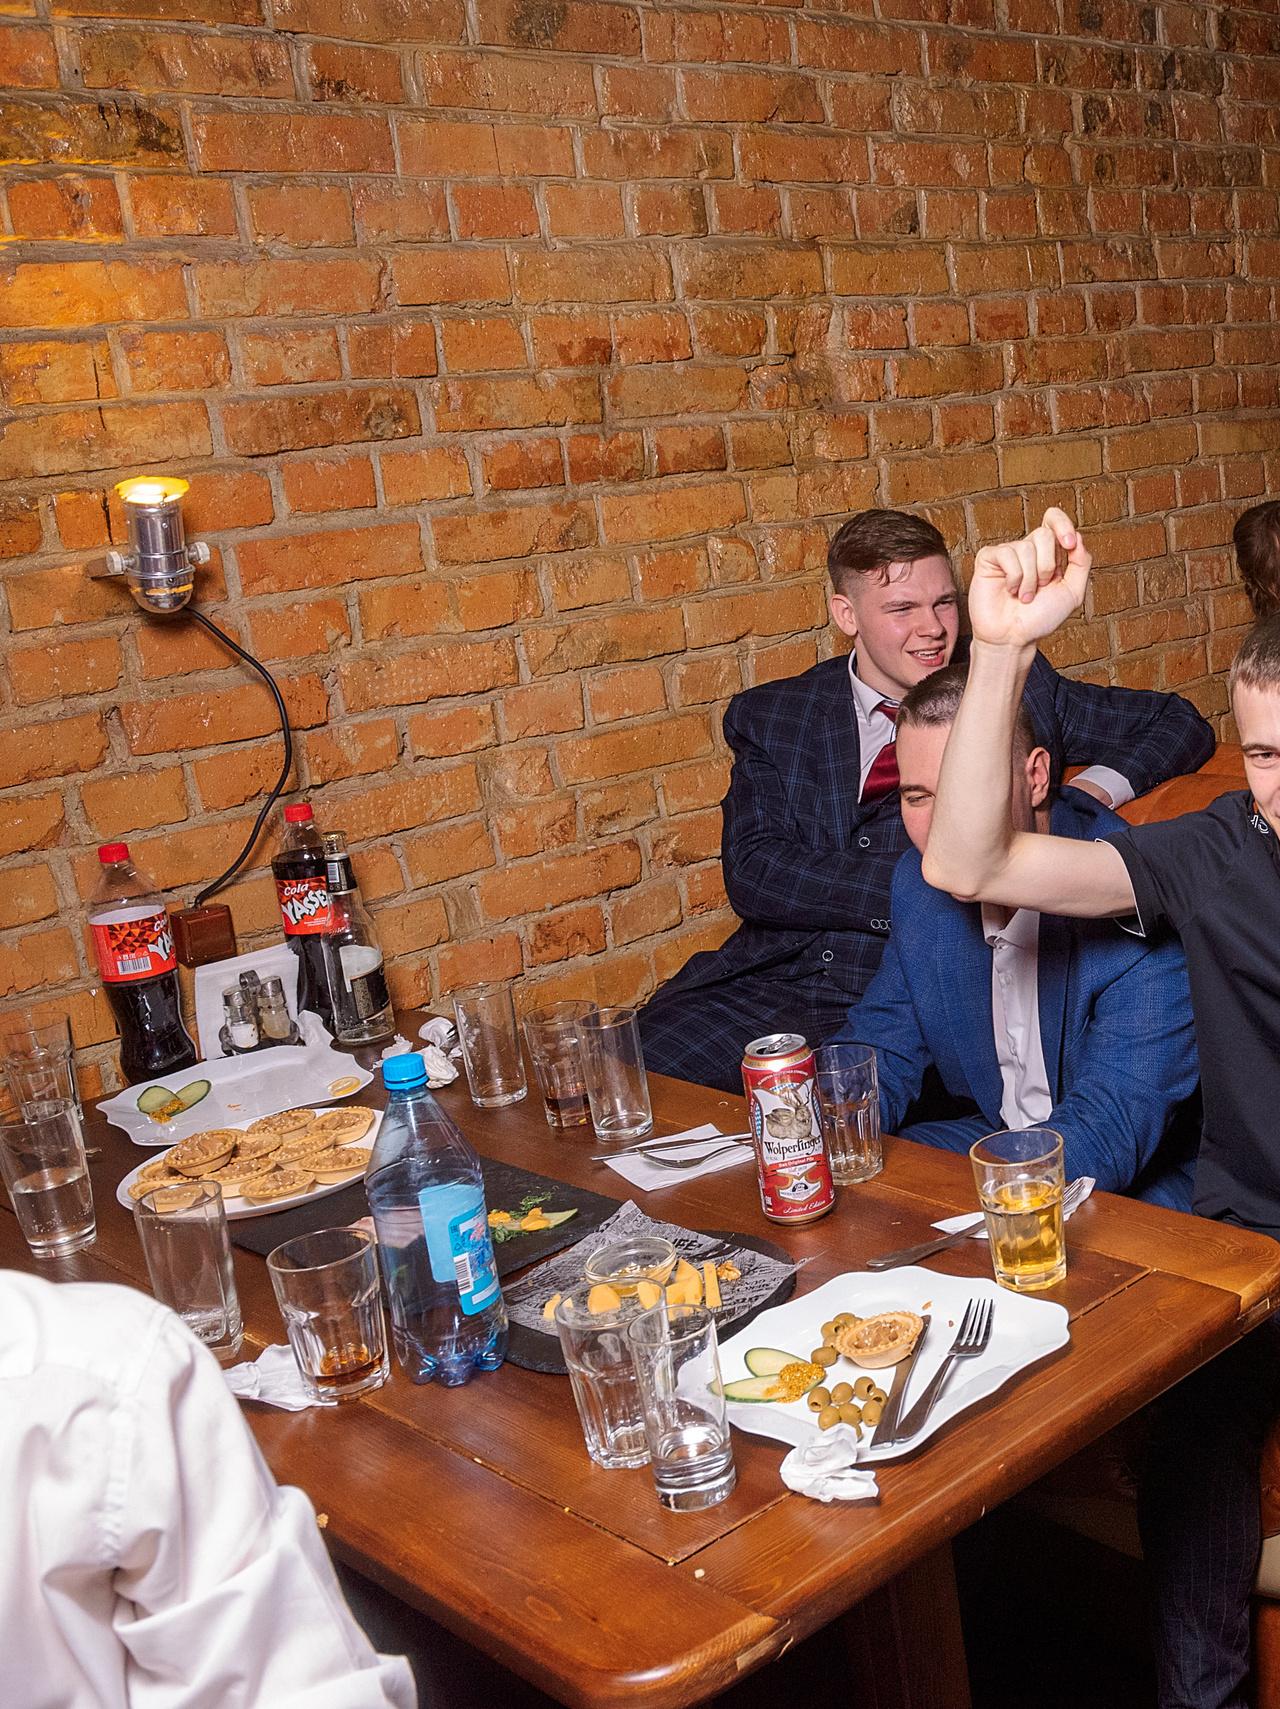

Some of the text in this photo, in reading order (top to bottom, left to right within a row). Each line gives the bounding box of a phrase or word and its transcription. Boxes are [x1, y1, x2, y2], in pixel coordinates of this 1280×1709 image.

[284, 883, 309, 896] Cola
[281, 889, 329, 925] YASSE
[147, 931, 174, 961] YA
